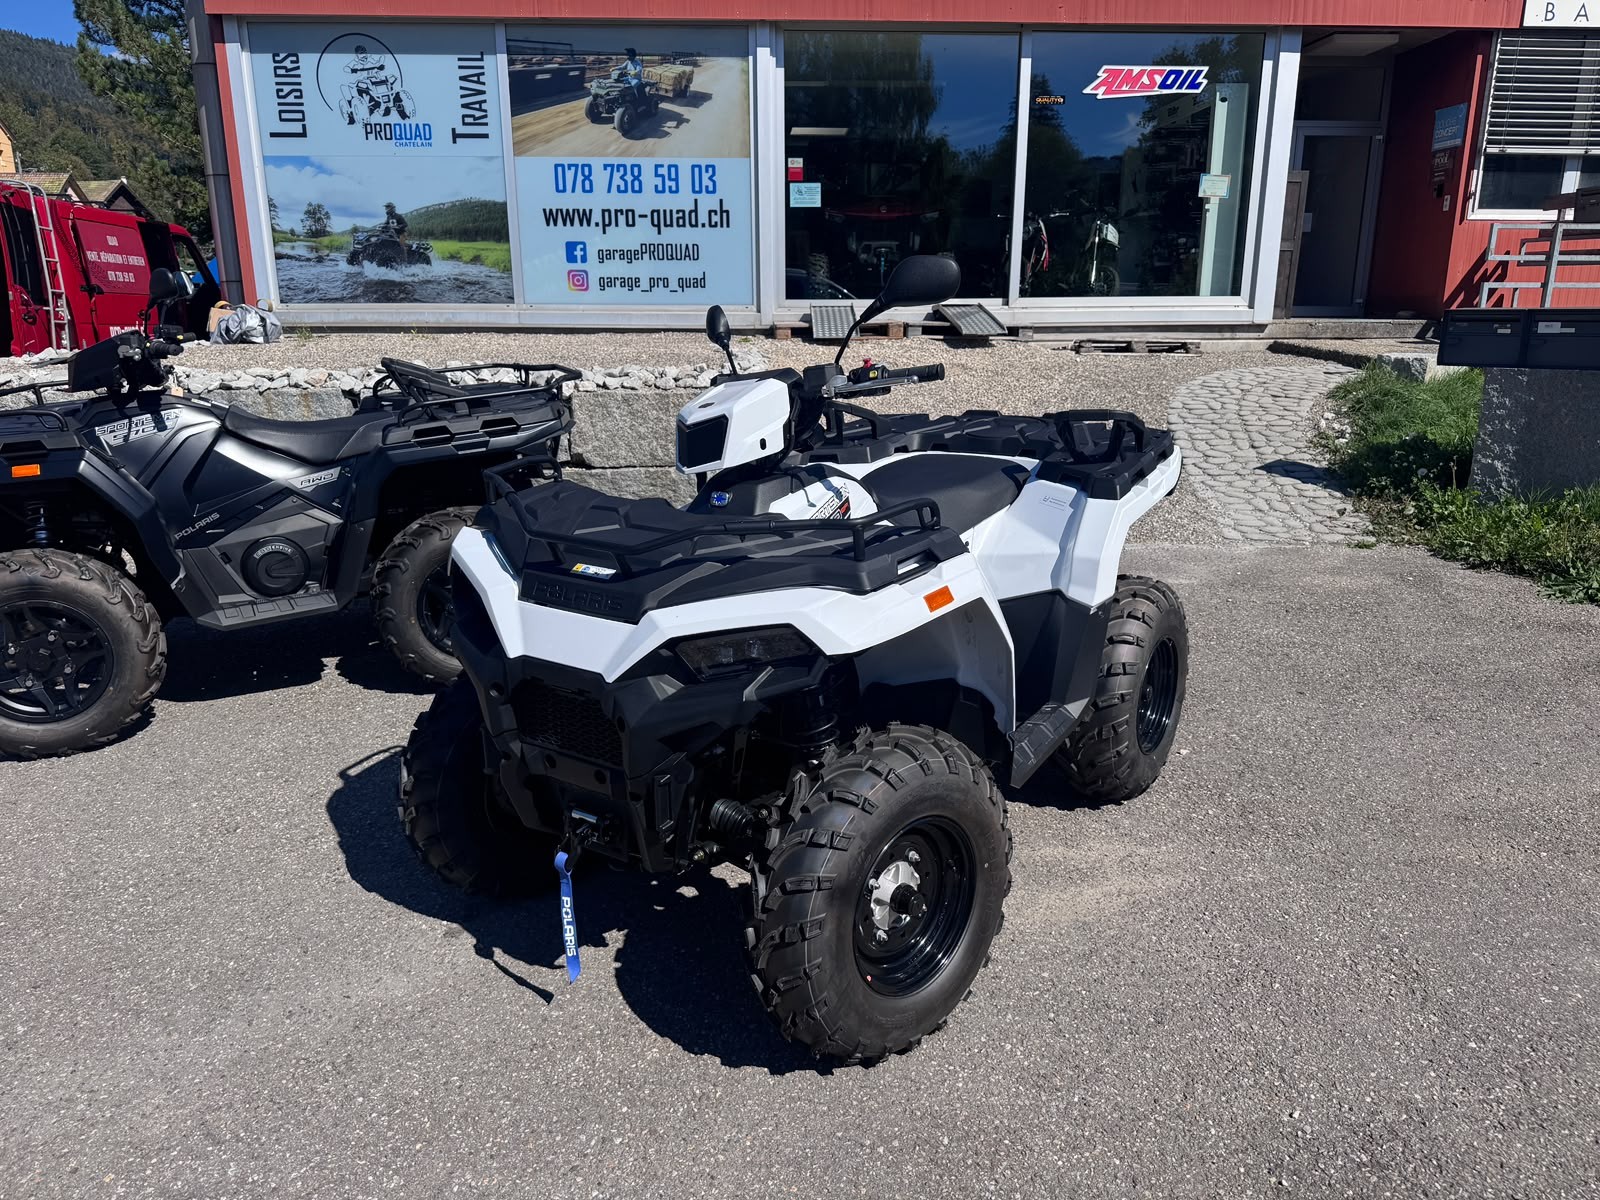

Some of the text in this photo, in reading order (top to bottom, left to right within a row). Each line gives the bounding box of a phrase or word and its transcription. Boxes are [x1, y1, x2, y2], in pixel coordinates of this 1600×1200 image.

[269, 52, 307, 138] LOISIRS
[1090, 68, 1205, 95] AMSOIL
[451, 51, 490, 144] TRAVAIL
[364, 123, 433, 141] PROQUAD
[554, 163, 717, 195] 078 738 59 03
[543, 198, 731, 235] www.pro-quad.ch
[597, 243, 700, 264] garagePROQUAD
[598, 271, 706, 293] garage_pro_quad
[300, 472, 335, 487] AWD
[174, 512, 220, 540] POLARIS
[562, 896, 577, 957] POLARIS
